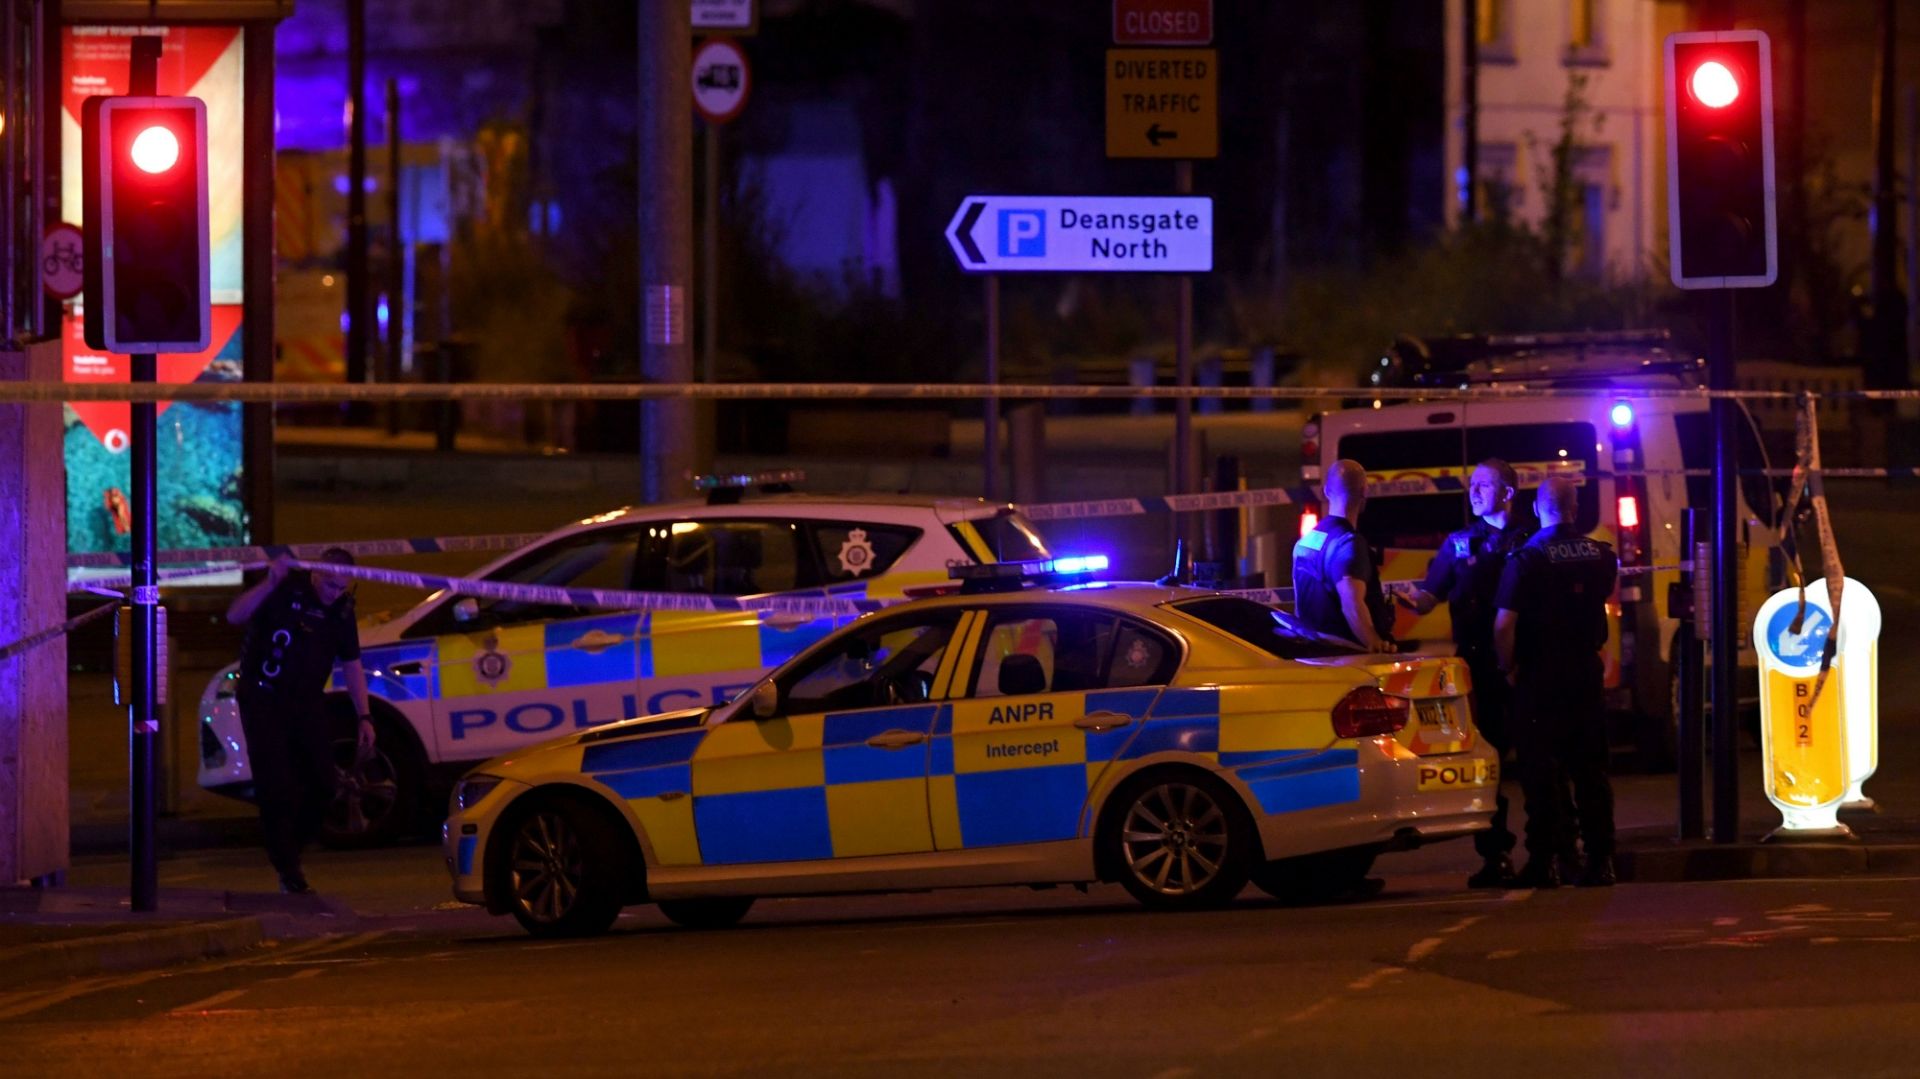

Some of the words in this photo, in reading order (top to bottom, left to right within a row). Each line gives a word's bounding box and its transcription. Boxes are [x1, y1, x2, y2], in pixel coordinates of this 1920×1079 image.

[1125, 11, 1200, 34] CLOSED
[1114, 60, 1207, 79] DIVERTED
[1123, 94, 1200, 113] TRAFFIC
[1060, 208, 1199, 234] Deansgate
[1008, 213, 1041, 255] P
[1091, 238, 1168, 259] North
[1548, 542, 1600, 559] POLICE
[448, 682, 757, 740] POLICE
[988, 702, 1054, 725] ANPR
[986, 739, 1059, 758] Intercept
